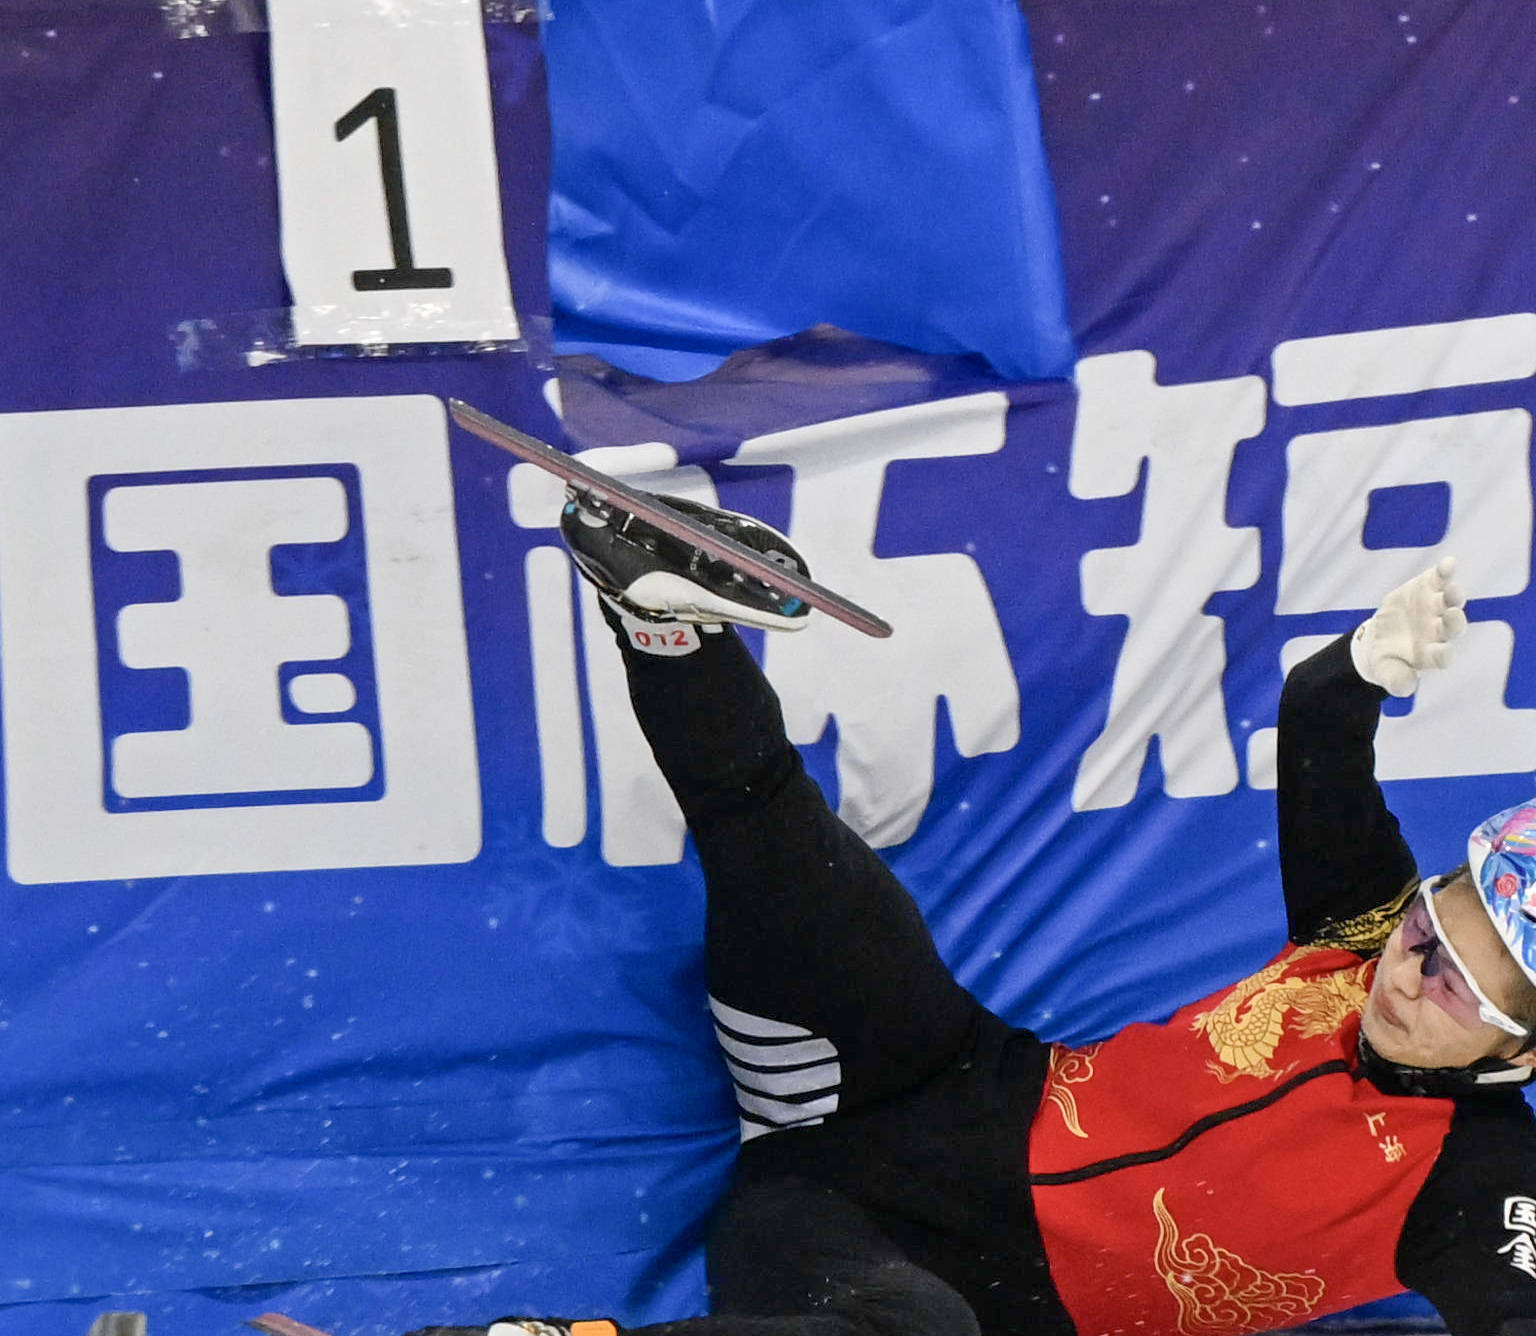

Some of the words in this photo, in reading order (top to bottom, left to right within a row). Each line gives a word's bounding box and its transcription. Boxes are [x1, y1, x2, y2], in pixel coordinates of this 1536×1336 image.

[332, 86, 455, 291] 1
[634, 630, 688, 647] 012
[1363, 1111, 1408, 1163] 上海
